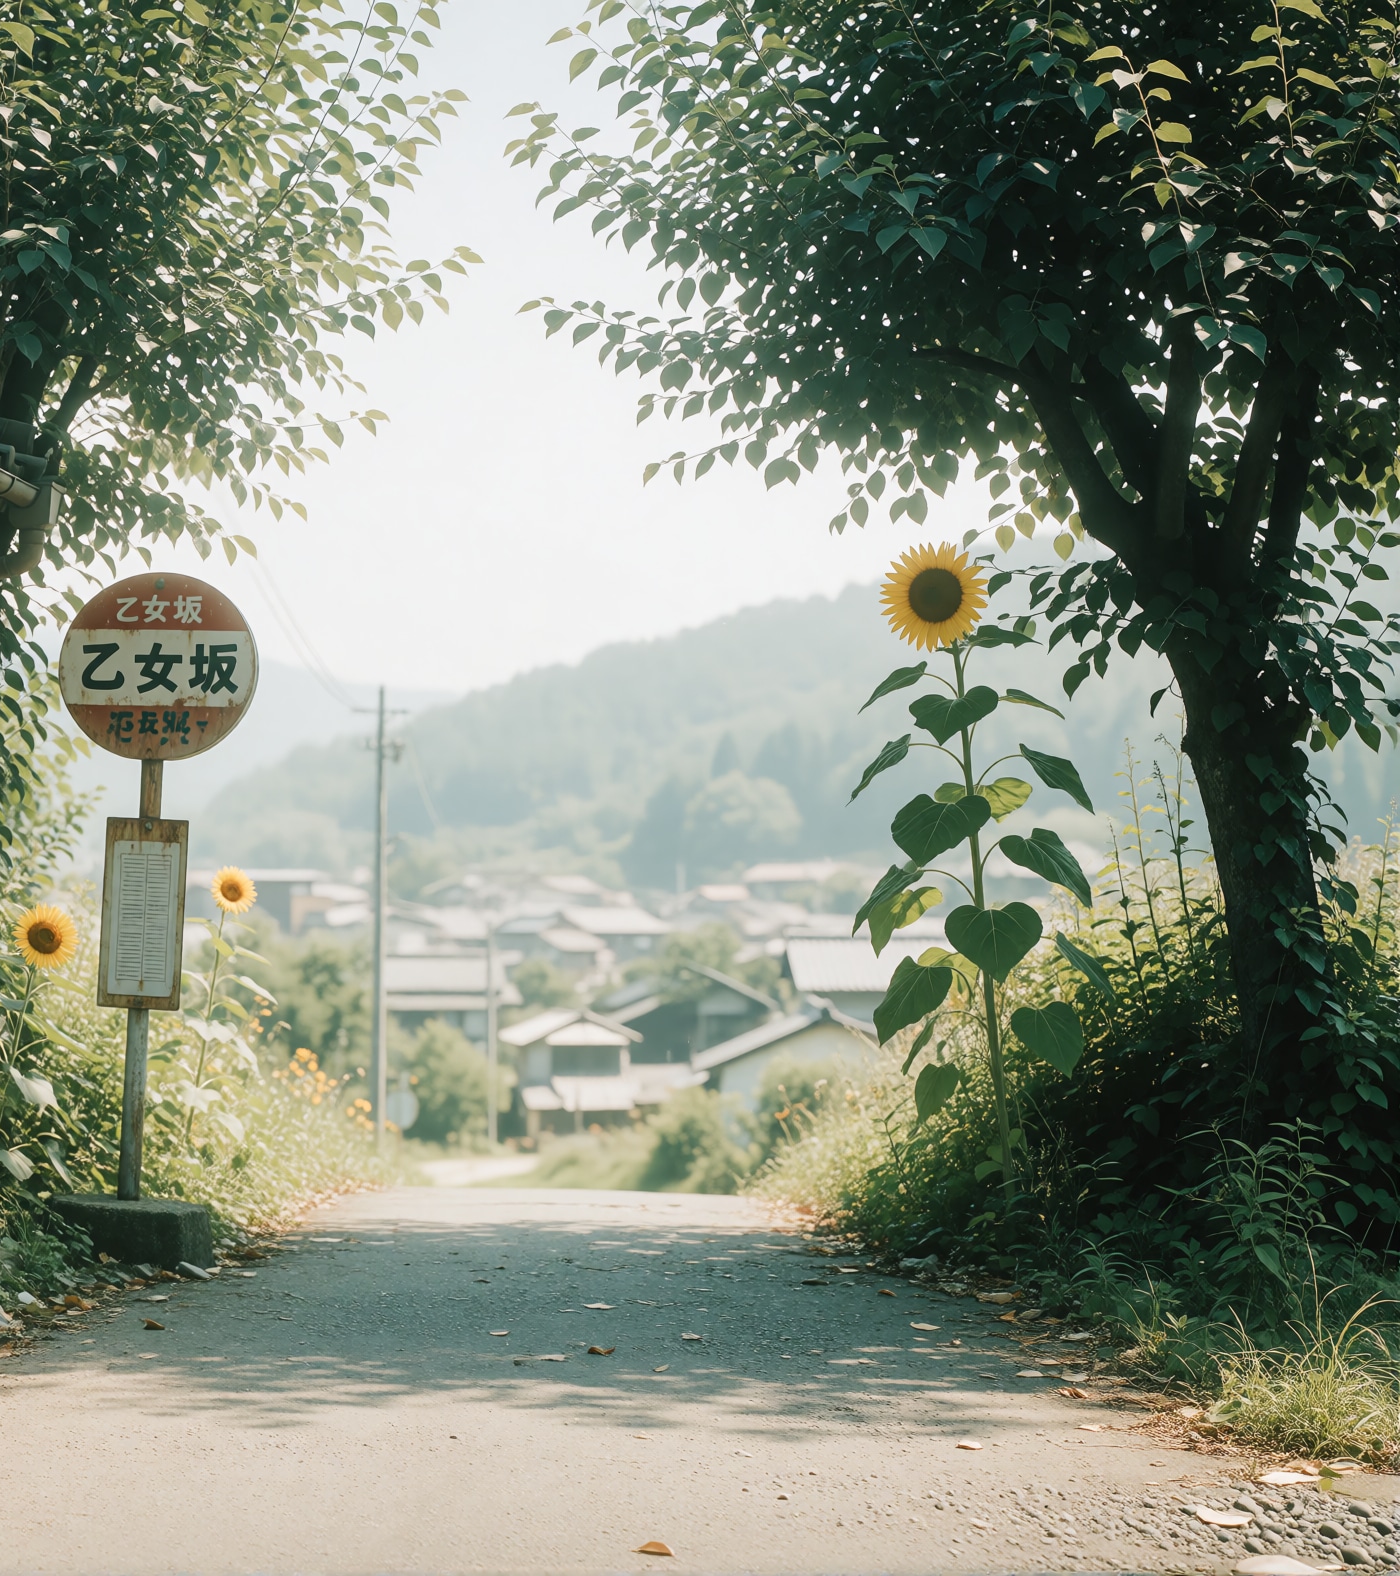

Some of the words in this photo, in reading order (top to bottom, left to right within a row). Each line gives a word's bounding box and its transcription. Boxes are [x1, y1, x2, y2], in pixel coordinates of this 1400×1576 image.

[116, 594, 203, 624] 乙女坂
[81, 642, 239, 695] 乙女坂
